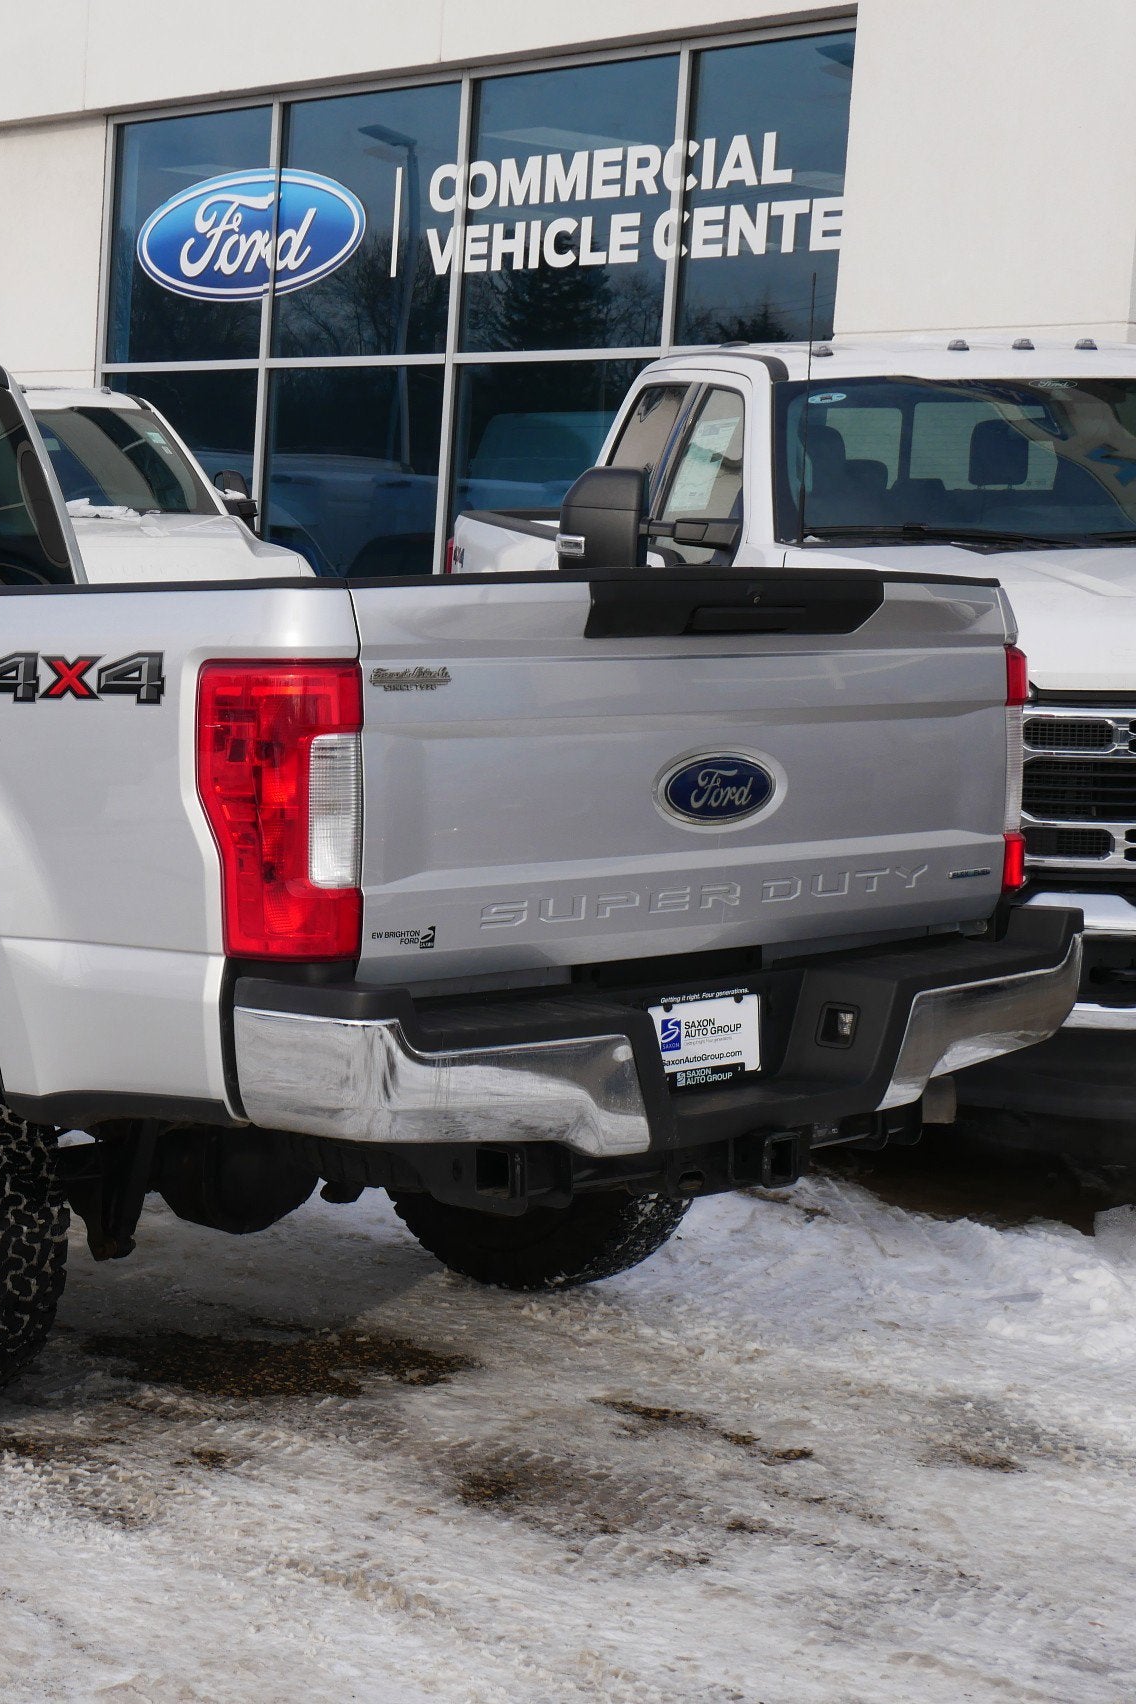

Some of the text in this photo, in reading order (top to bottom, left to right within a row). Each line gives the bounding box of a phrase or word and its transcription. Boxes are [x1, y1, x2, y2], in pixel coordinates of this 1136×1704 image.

[429, 131, 793, 213] COMMERCIAL
[179, 190, 317, 278] Ford
[426, 196, 844, 276] VEHICLE CENTE
[690, 769, 754, 808] Ford
[480, 864, 928, 930] SUPER DUTY
[384, 930, 421, 938] BRIGHTON
[399, 937, 420, 945] FORD
[684, 1023, 742, 1039] AUTO GROUP
[685, 1017, 716, 1030] SAXON
[662, 1042, 681, 1050] SAXON
[663, 1050, 743, 1067] SaxonAutoGroup.com
[686, 1068, 712, 1078] SAXON
[686, 1072, 733, 1086] AUTO GROUP
